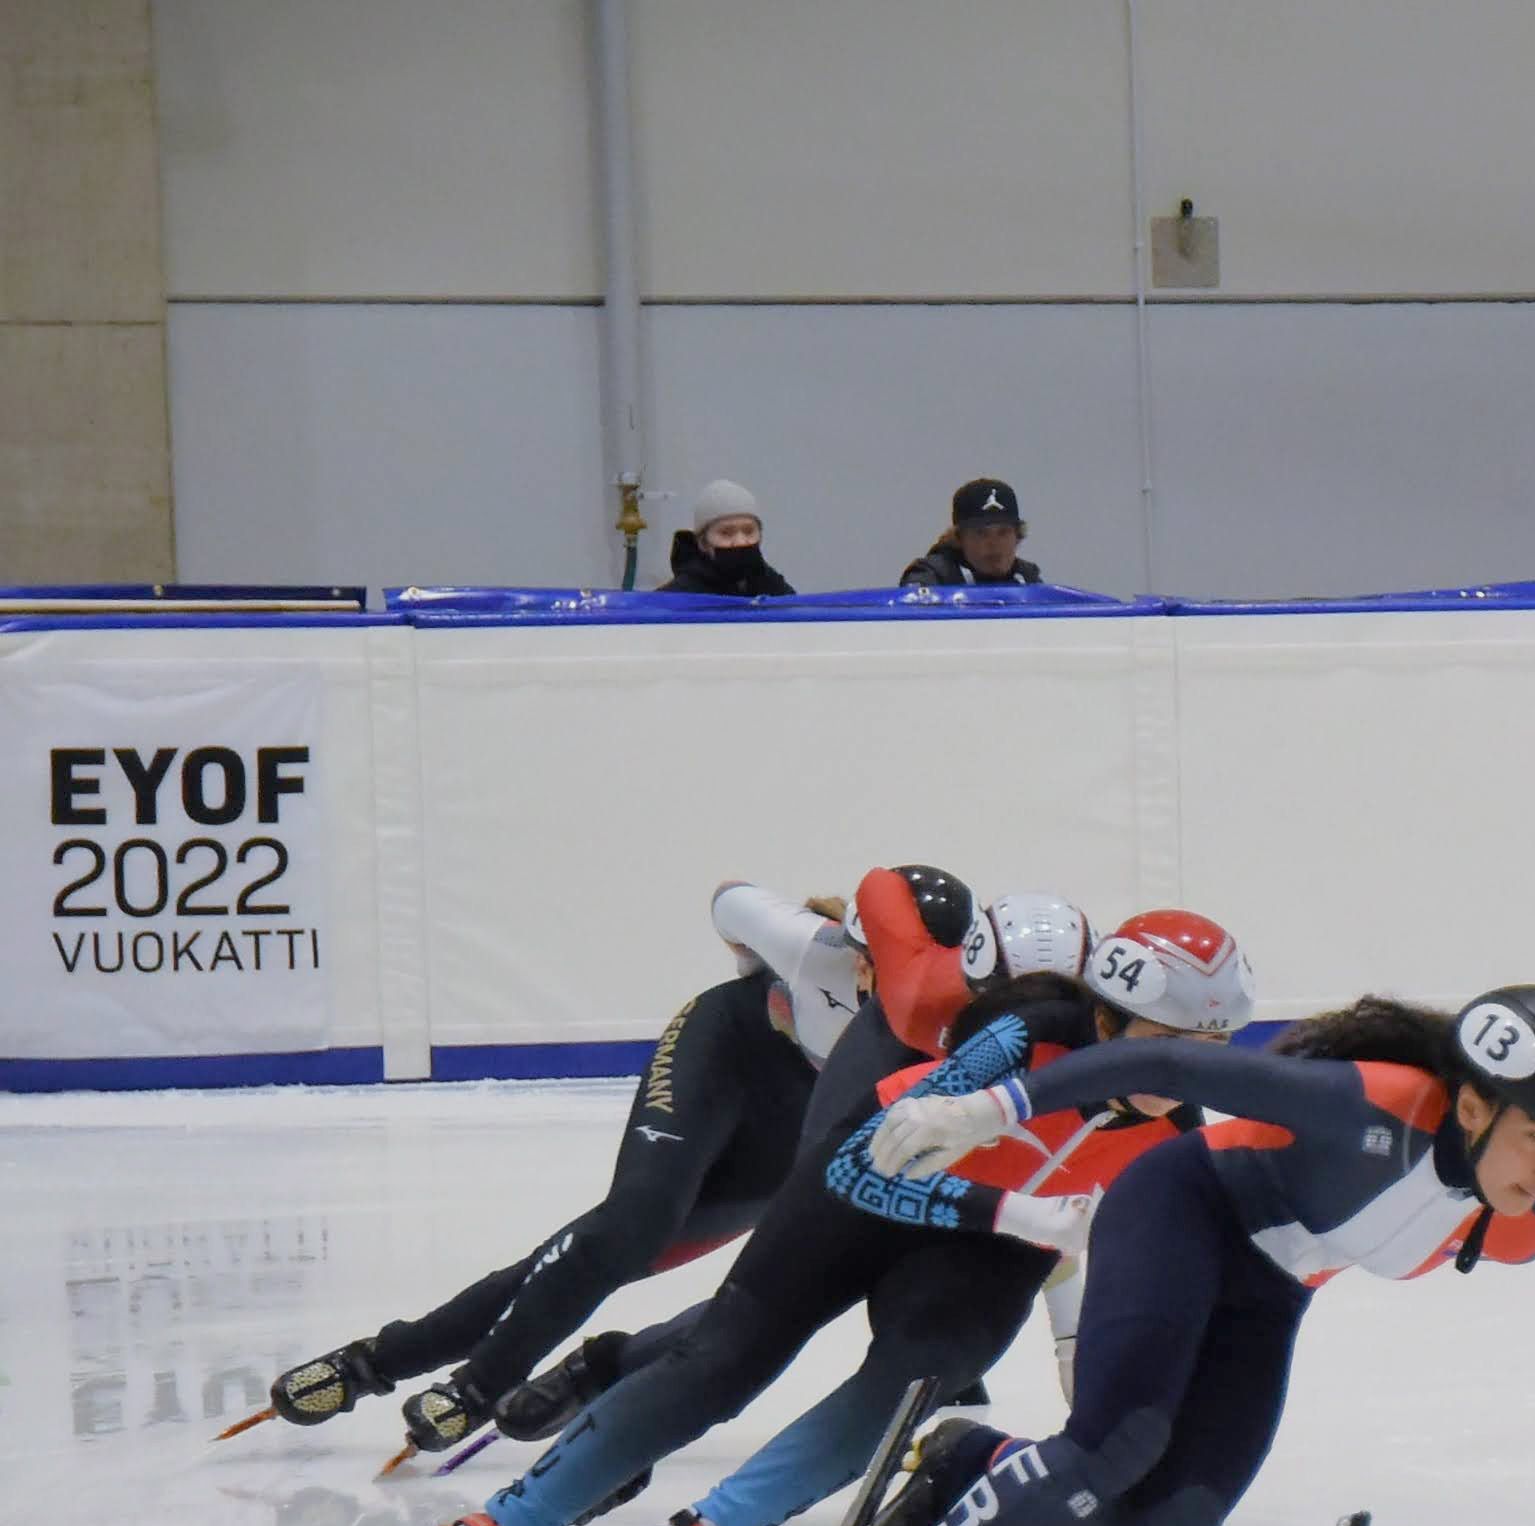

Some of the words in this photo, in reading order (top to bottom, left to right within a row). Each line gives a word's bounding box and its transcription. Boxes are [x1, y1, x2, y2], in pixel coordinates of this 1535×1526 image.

[50, 746, 310, 826] EYOF
[52, 837, 290, 917] 2022
[52, 928, 320, 974] VUOKATTI
[1100, 945, 1147, 993] 54
[1472, 1013, 1521, 1062] 13
